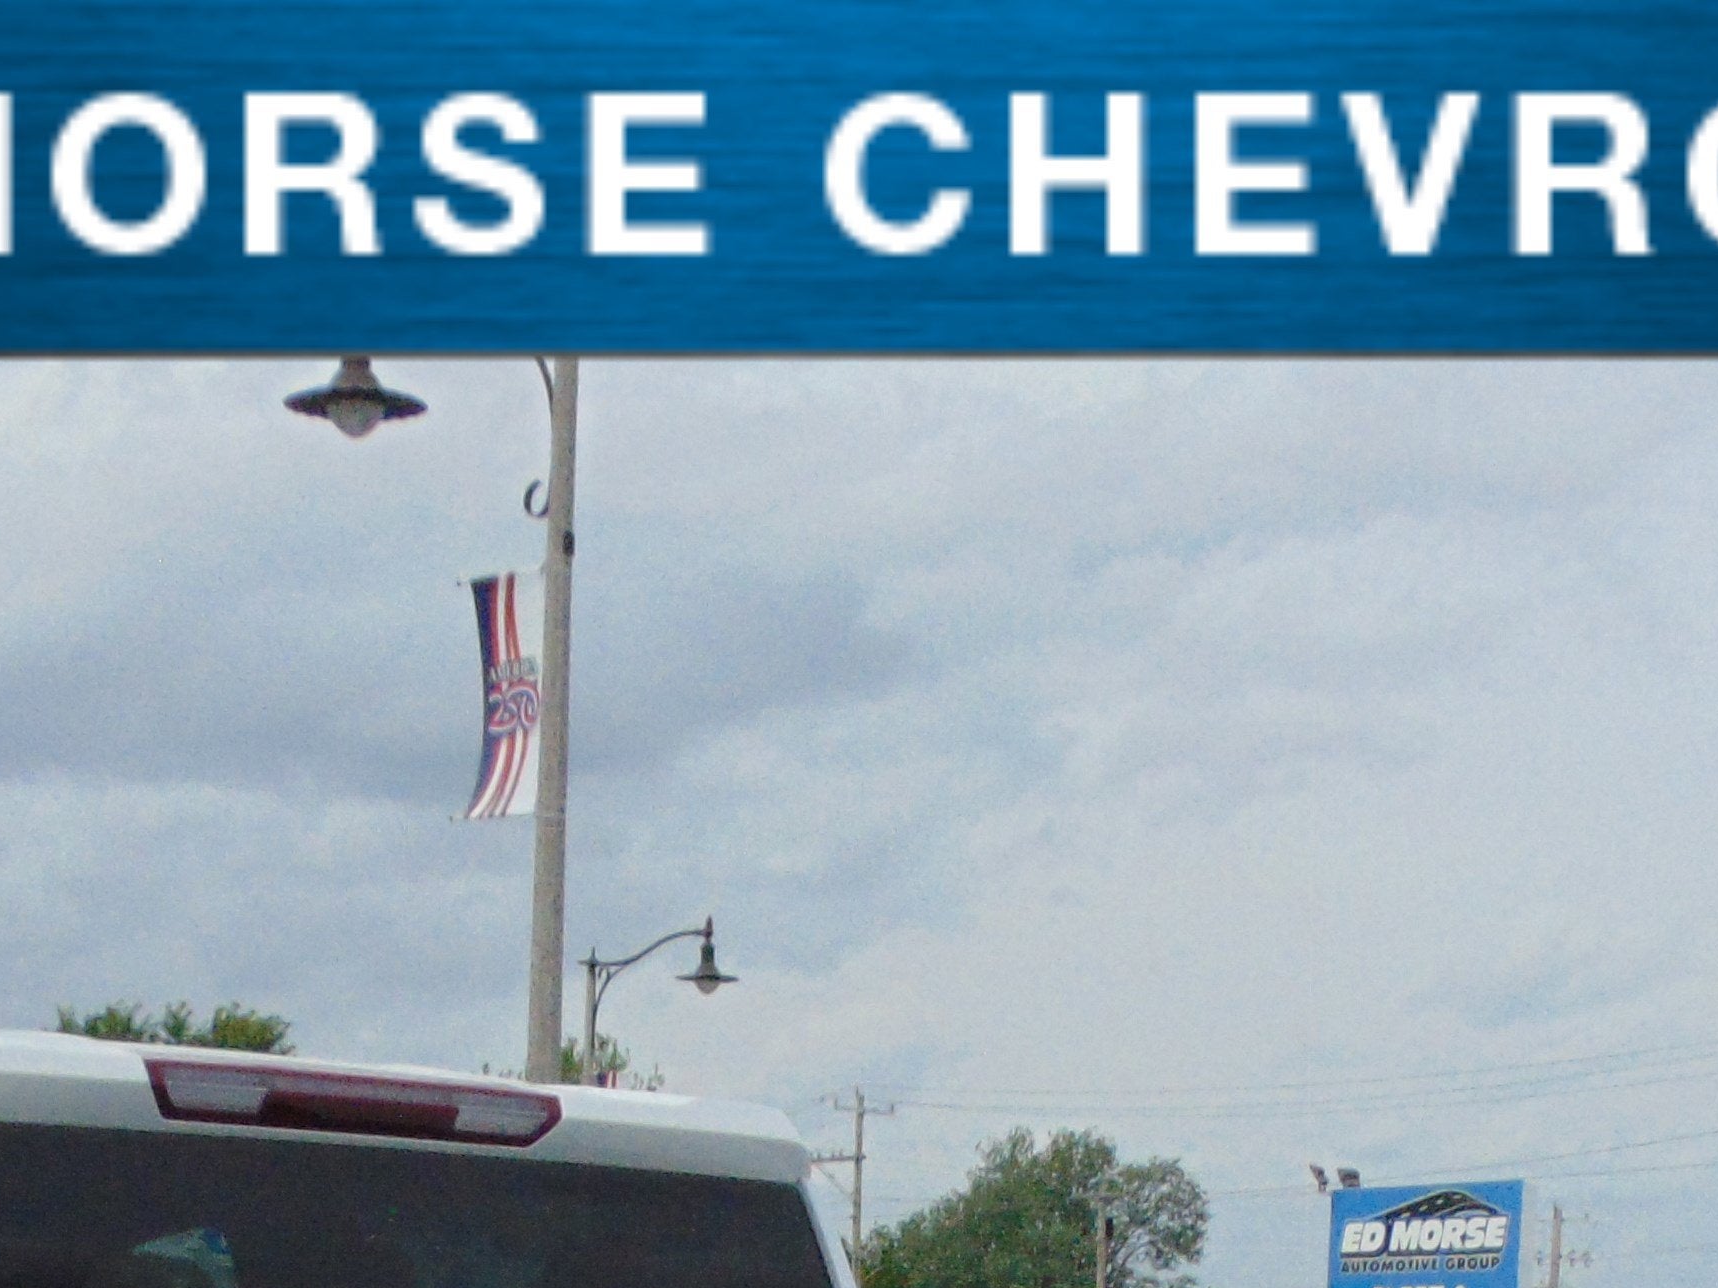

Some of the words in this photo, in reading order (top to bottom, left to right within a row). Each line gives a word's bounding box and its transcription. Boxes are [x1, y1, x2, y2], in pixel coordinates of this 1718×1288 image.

[1340, 1221, 1387, 1255] ED
[1388, 1215, 1509, 1254] MORSE
[1340, 1258, 1438, 1273] AUTOMOTIVE
[1444, 1256, 1501, 1271] GROUP
